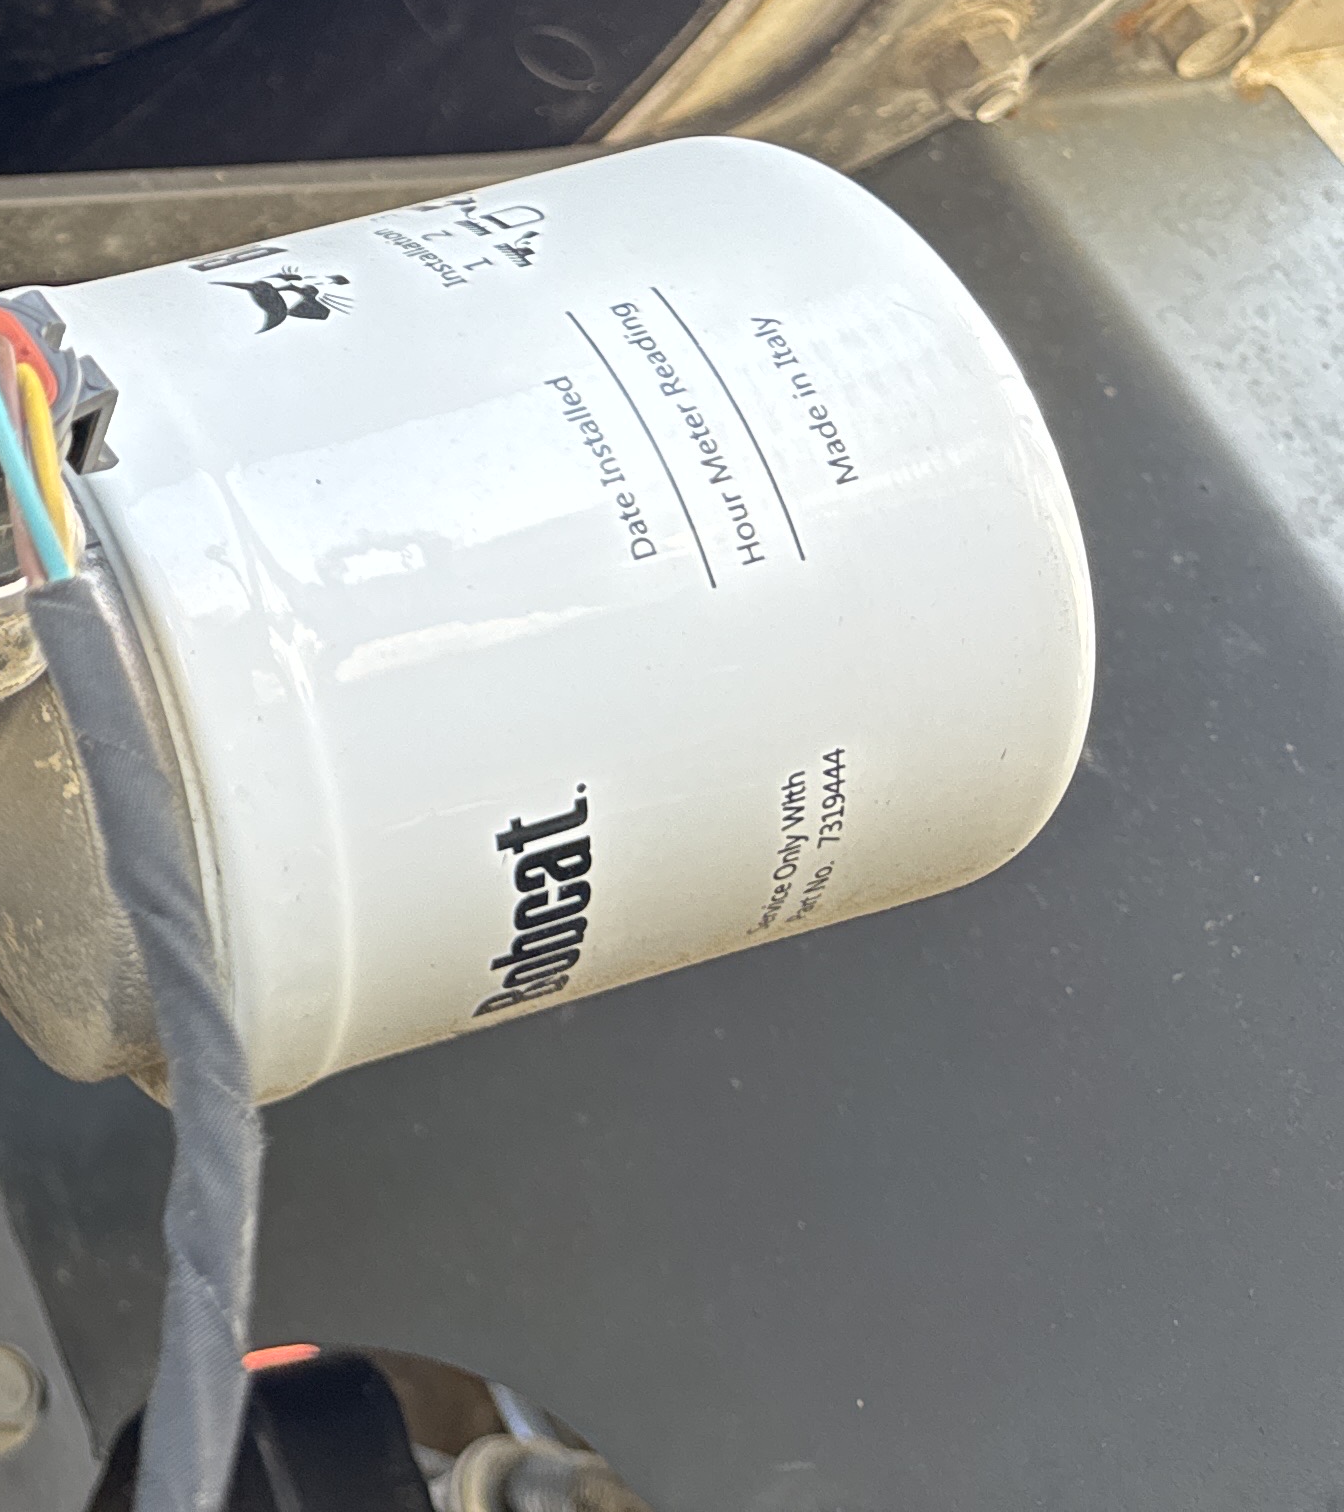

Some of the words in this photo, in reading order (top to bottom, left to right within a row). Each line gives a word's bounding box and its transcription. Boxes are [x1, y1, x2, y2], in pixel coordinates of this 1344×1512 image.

[374, 227, 468, 288] Installation
[611, 303, 686, 396] Reading
[750, 317, 798, 369] Italy
[791, 373, 817, 400] in
[544, 375, 625, 486] Installed
[677, 402, 732, 484] Meter
[808, 404, 859, 485] Made
[617, 491, 657, 561] Date
[721, 491, 765, 566] Hour
[781, 770, 806, 832] With
[817, 748, 846, 849] 7319444
[773, 835, 809, 881] Only
[802, 859, 835, 895] No.
